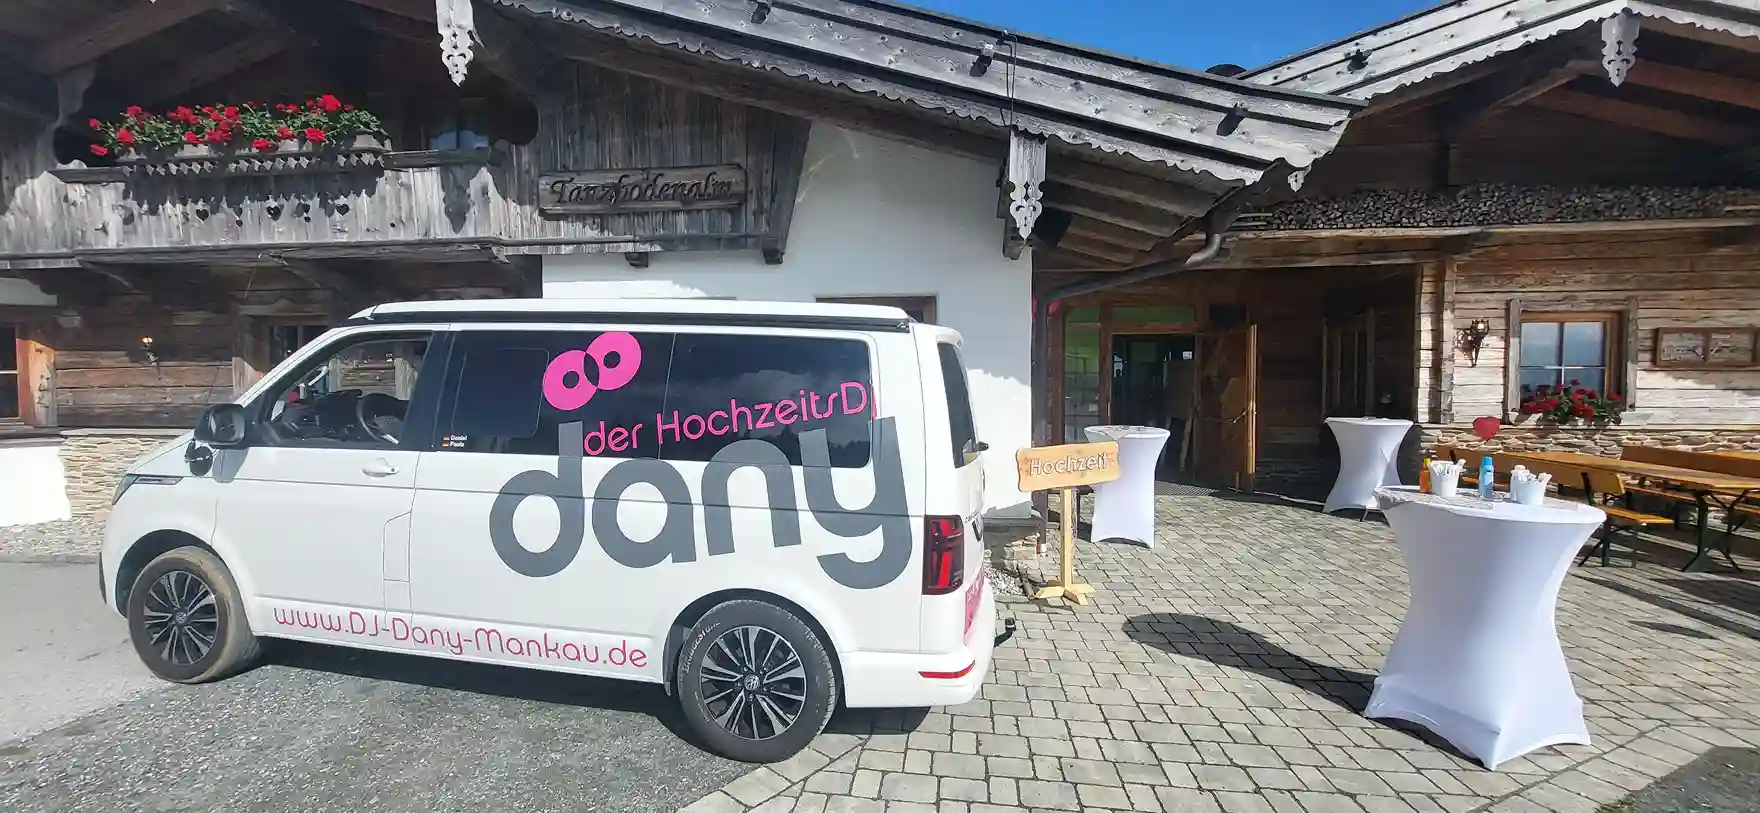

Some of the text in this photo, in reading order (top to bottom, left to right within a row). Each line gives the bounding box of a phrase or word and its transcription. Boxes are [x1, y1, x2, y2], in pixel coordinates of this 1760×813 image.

[550, 172, 731, 204] Tanzbodenalm
[584, 420, 642, 455] der
[1029, 452, 1108, 477] Hochzeit
[489, 416, 913, 590] dany
[273, 607, 648, 668] www.DJ-Dany-Mankau.de
